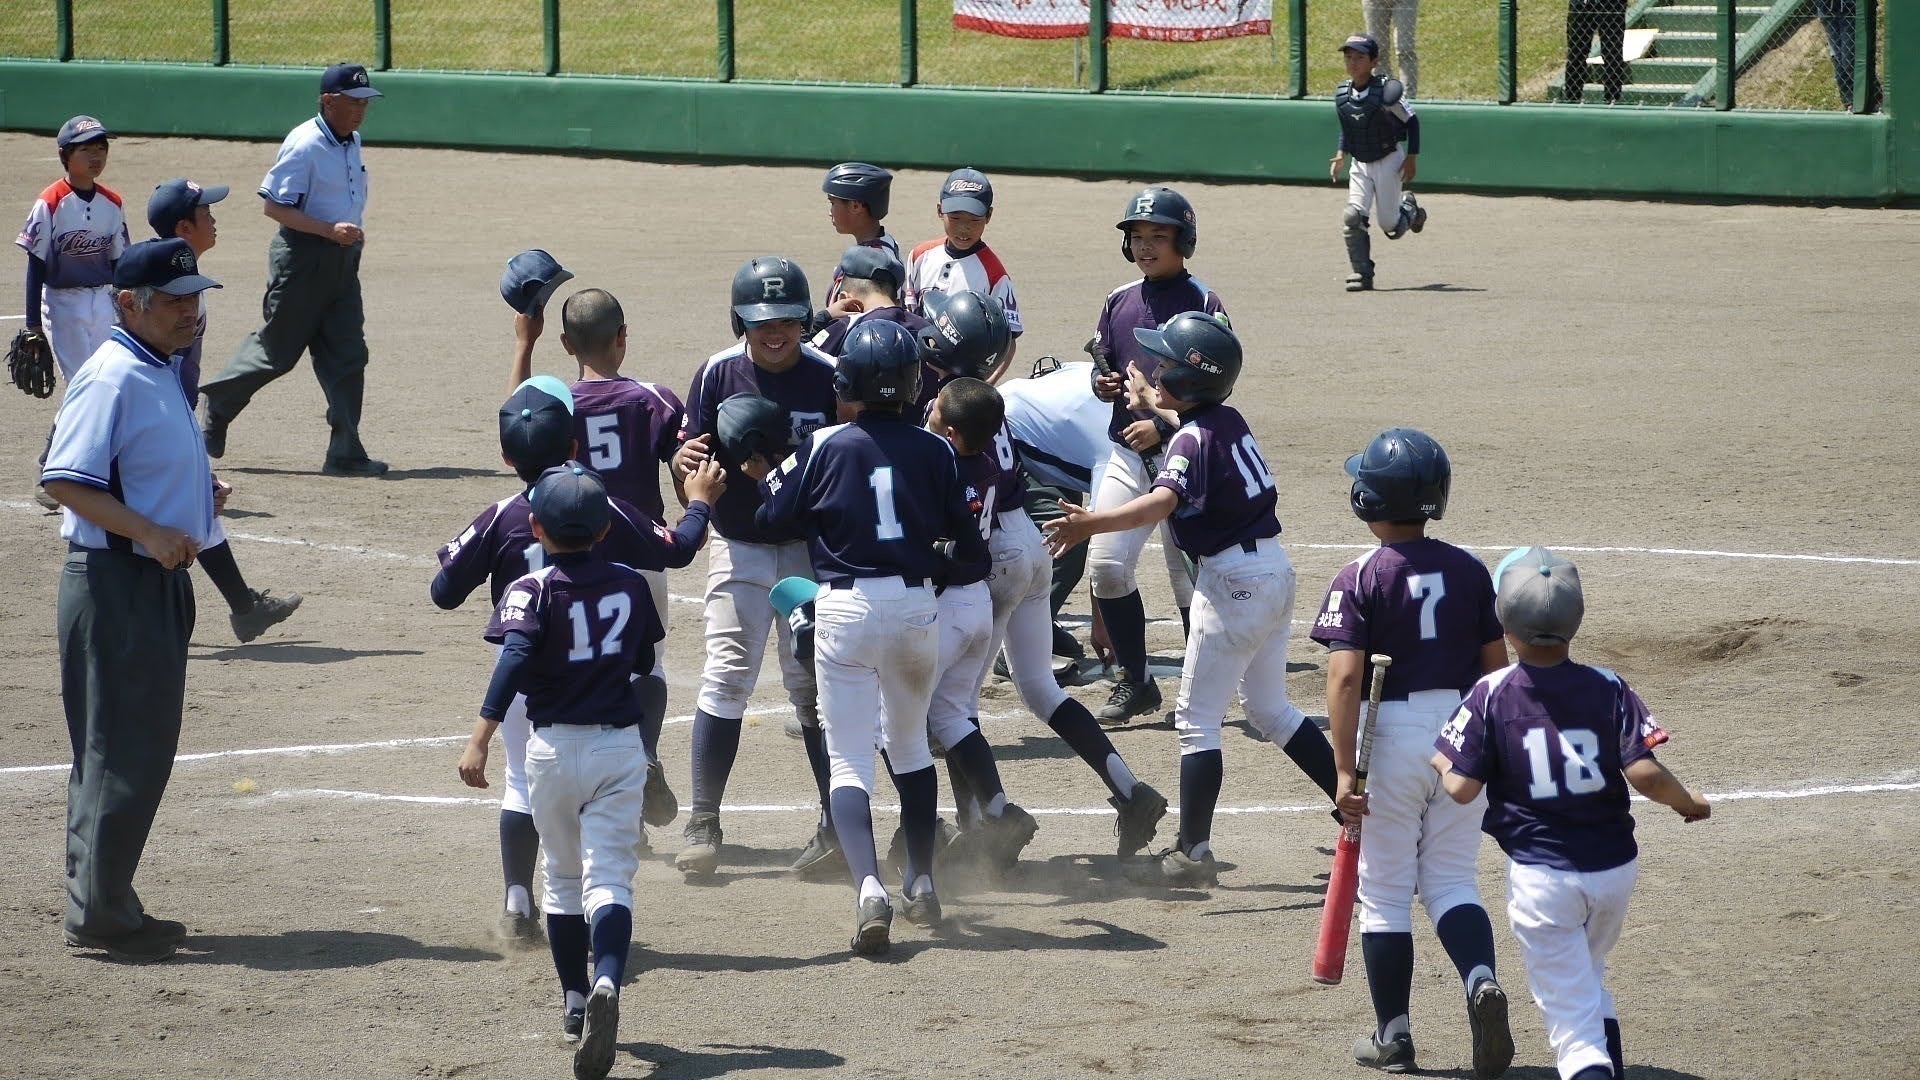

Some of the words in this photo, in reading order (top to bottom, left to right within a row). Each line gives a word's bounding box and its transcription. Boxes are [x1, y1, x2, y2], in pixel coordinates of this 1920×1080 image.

[950, 179, 983, 192] Tigers
[1134, 197, 1155, 214] R
[57, 229, 113, 257] Tigers
[761, 276, 787, 299] R
[985, 352, 998, 366] 4
[585, 412, 623, 472] 5
[1231, 433, 1276, 499] 10
[869, 466, 905, 541] 1
[979, 484, 996, 540] 4
[568, 591, 631, 662] 12
[1406, 571, 1446, 641] 7
[1522, 727, 1606, 799] 18
